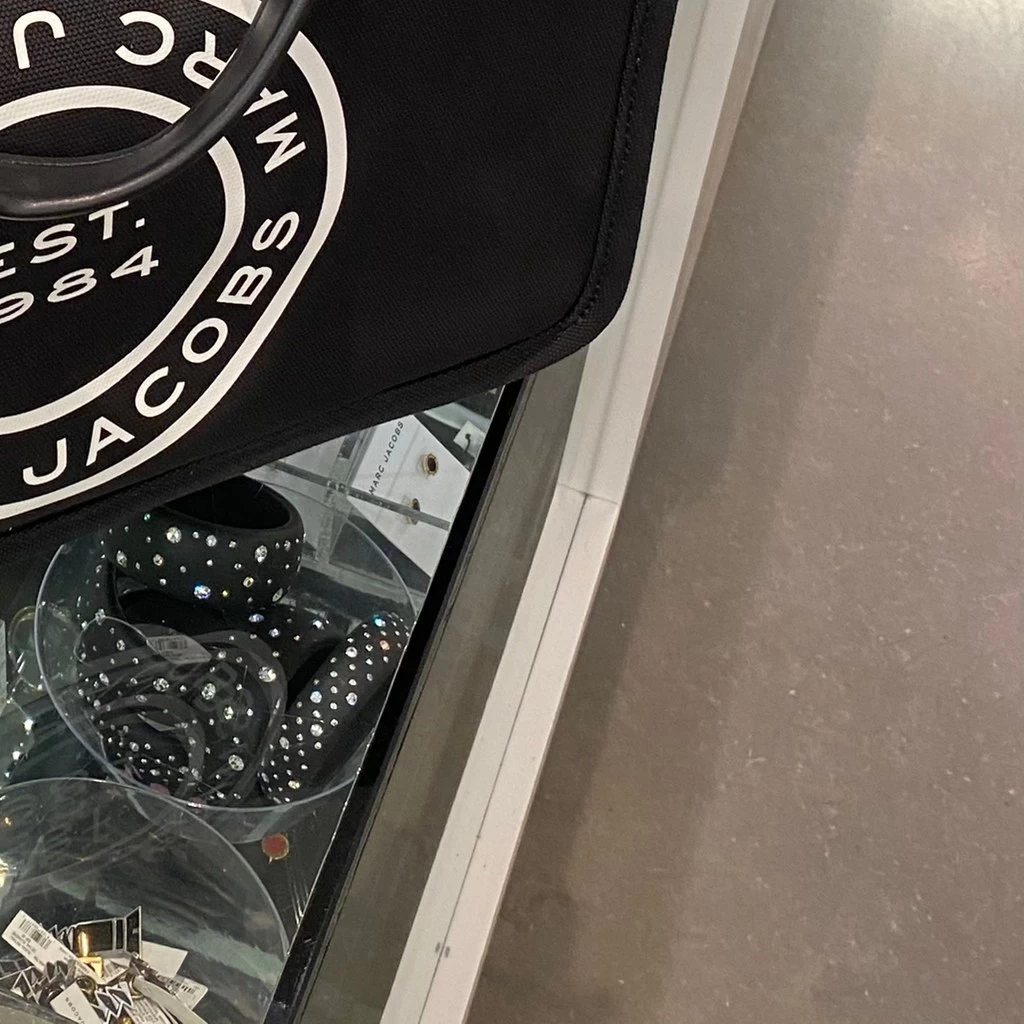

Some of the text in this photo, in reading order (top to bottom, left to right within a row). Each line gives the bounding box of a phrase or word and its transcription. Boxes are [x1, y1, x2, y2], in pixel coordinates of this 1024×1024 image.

[21, 211, 300, 486] JACOBS
[368, 421, 404, 496] MARC JACOBS
